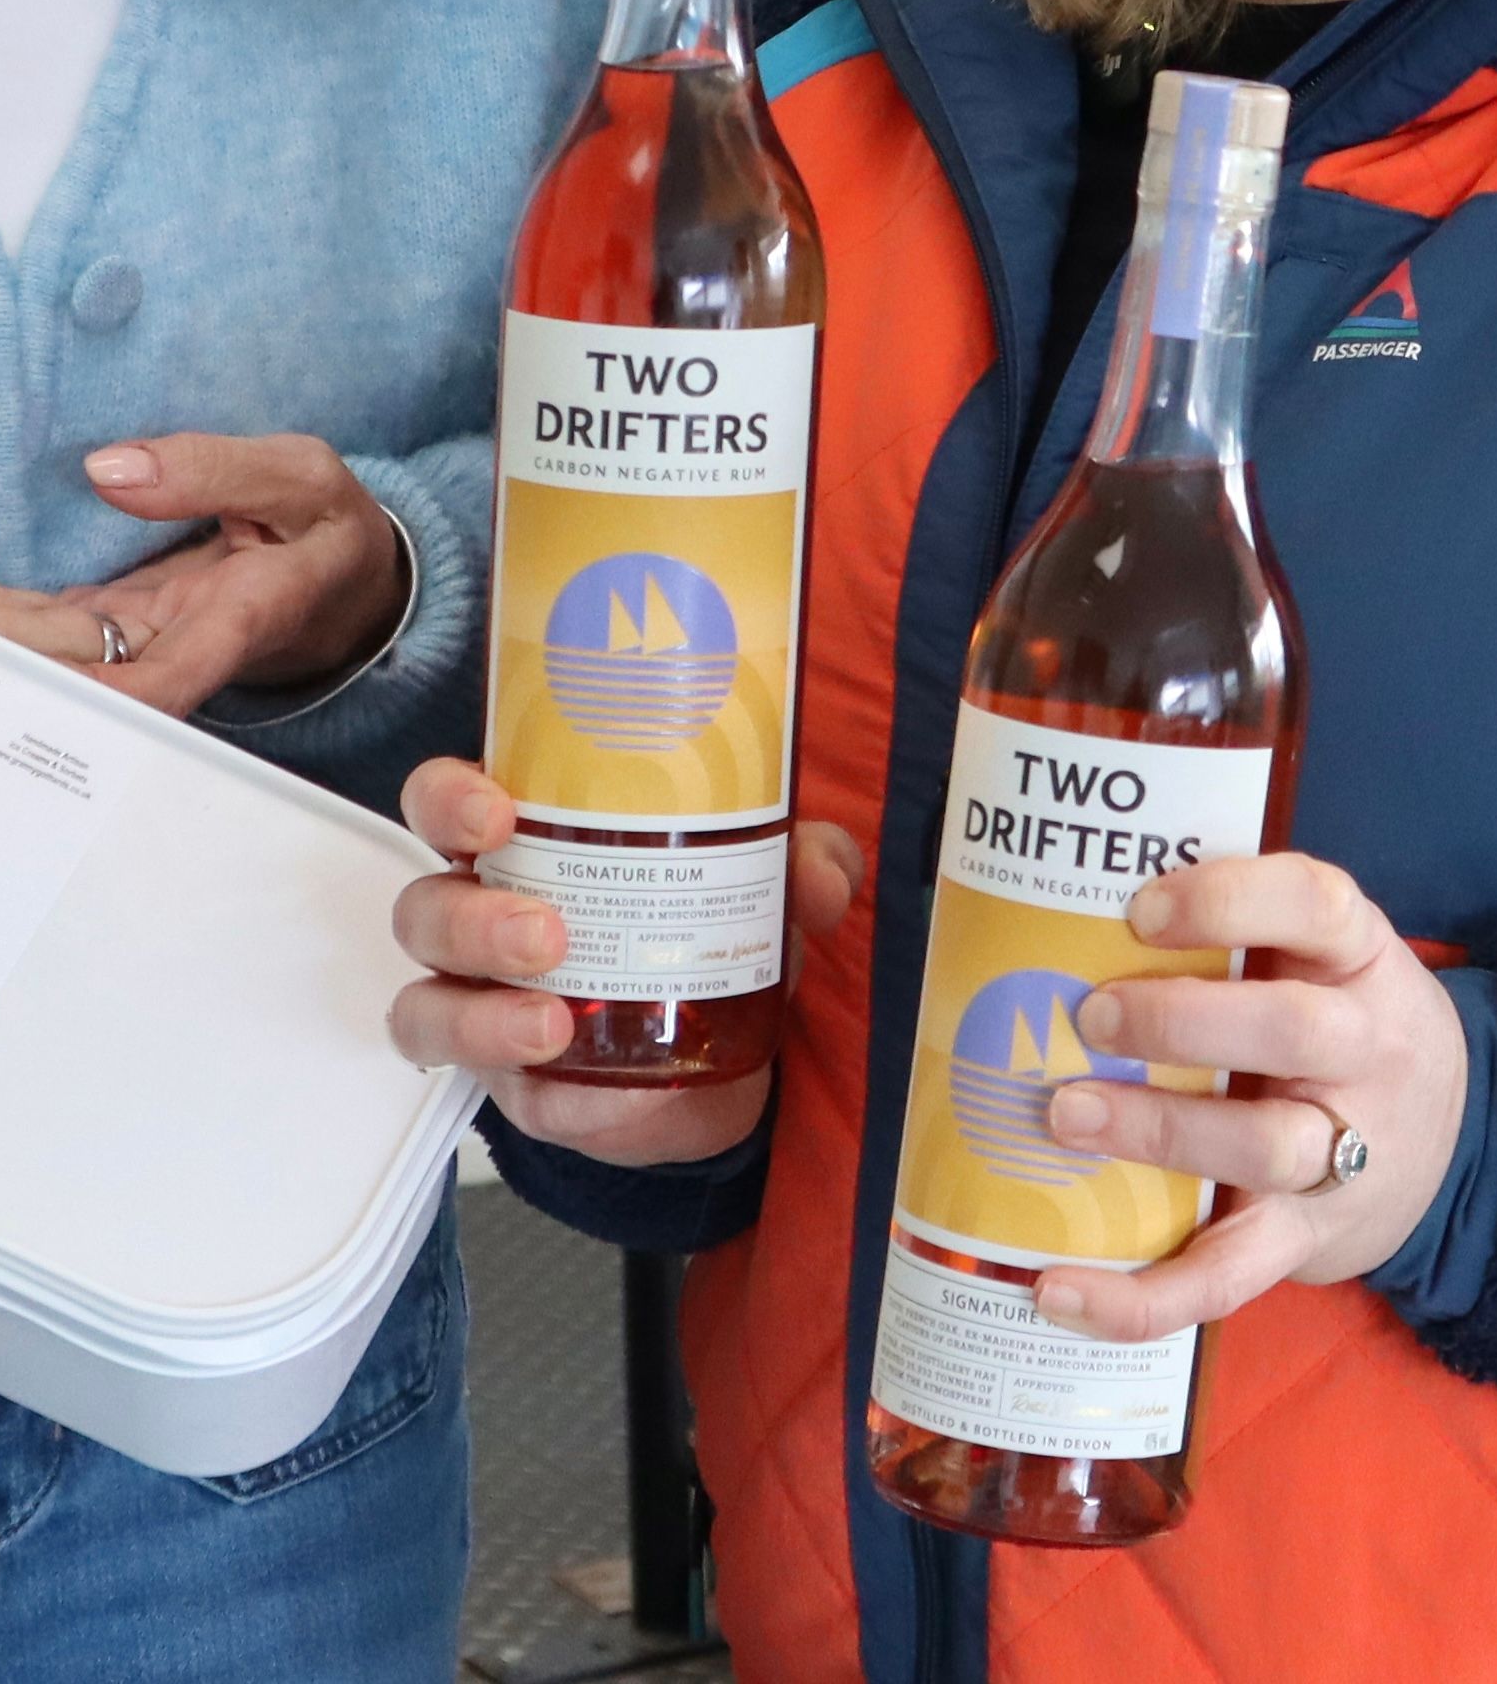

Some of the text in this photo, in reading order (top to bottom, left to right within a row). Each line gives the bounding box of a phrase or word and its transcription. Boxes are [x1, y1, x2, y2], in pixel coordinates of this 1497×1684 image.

[1312, 341, 1422, 362] PASSENGER
[586, 351, 718, 398] TWO
[535, 401, 768, 454] DRIFTERS
[534, 456, 767, 482] CARBON NEGATIVE RUM
[1014, 751, 1145, 813] TWO
[964, 798, 1200, 877] DRIFTERS
[557, 861, 703, 883] SIGNATURE RUM
[959, 856, 1023, 886] CARBON
[701, 895, 738, 906] IMPART
[740, 888, 771, 901] GENTLE
[566, 906, 612, 919] ORANGE
[616, 910, 644, 920] PEEL
[658, 908, 725, 920] MUSCOVADO
[728, 904, 757, 916] SUGAR
[598, 931, 621, 941] HAS
[567, 953, 617, 965] OSPHERE
[604, 944, 619, 954] OF
[588, 980, 596, 991] &
[602, 981, 663, 994] BOTTLED
[669, 983, 683, 993] IN
[688, 980, 729, 993] DEVON
[941, 1289, 1039, 1325] SIGNATURE
[946, 1338, 990, 1356] ORANGE
[993, 1349, 1021, 1363] PEEL
[1038, 1356, 1113, 1372] MUSCOVADO
[1116, 1363, 1151, 1373] SUGAR
[1086, 1349, 1128, 1358] IMPART
[1131, 1349, 1171, 1359] GENTLE
[974, 1370, 997, 1382] HAS
[901, 1399, 1112, 1451] DISTILLED & BOTTLED IN DEVON
